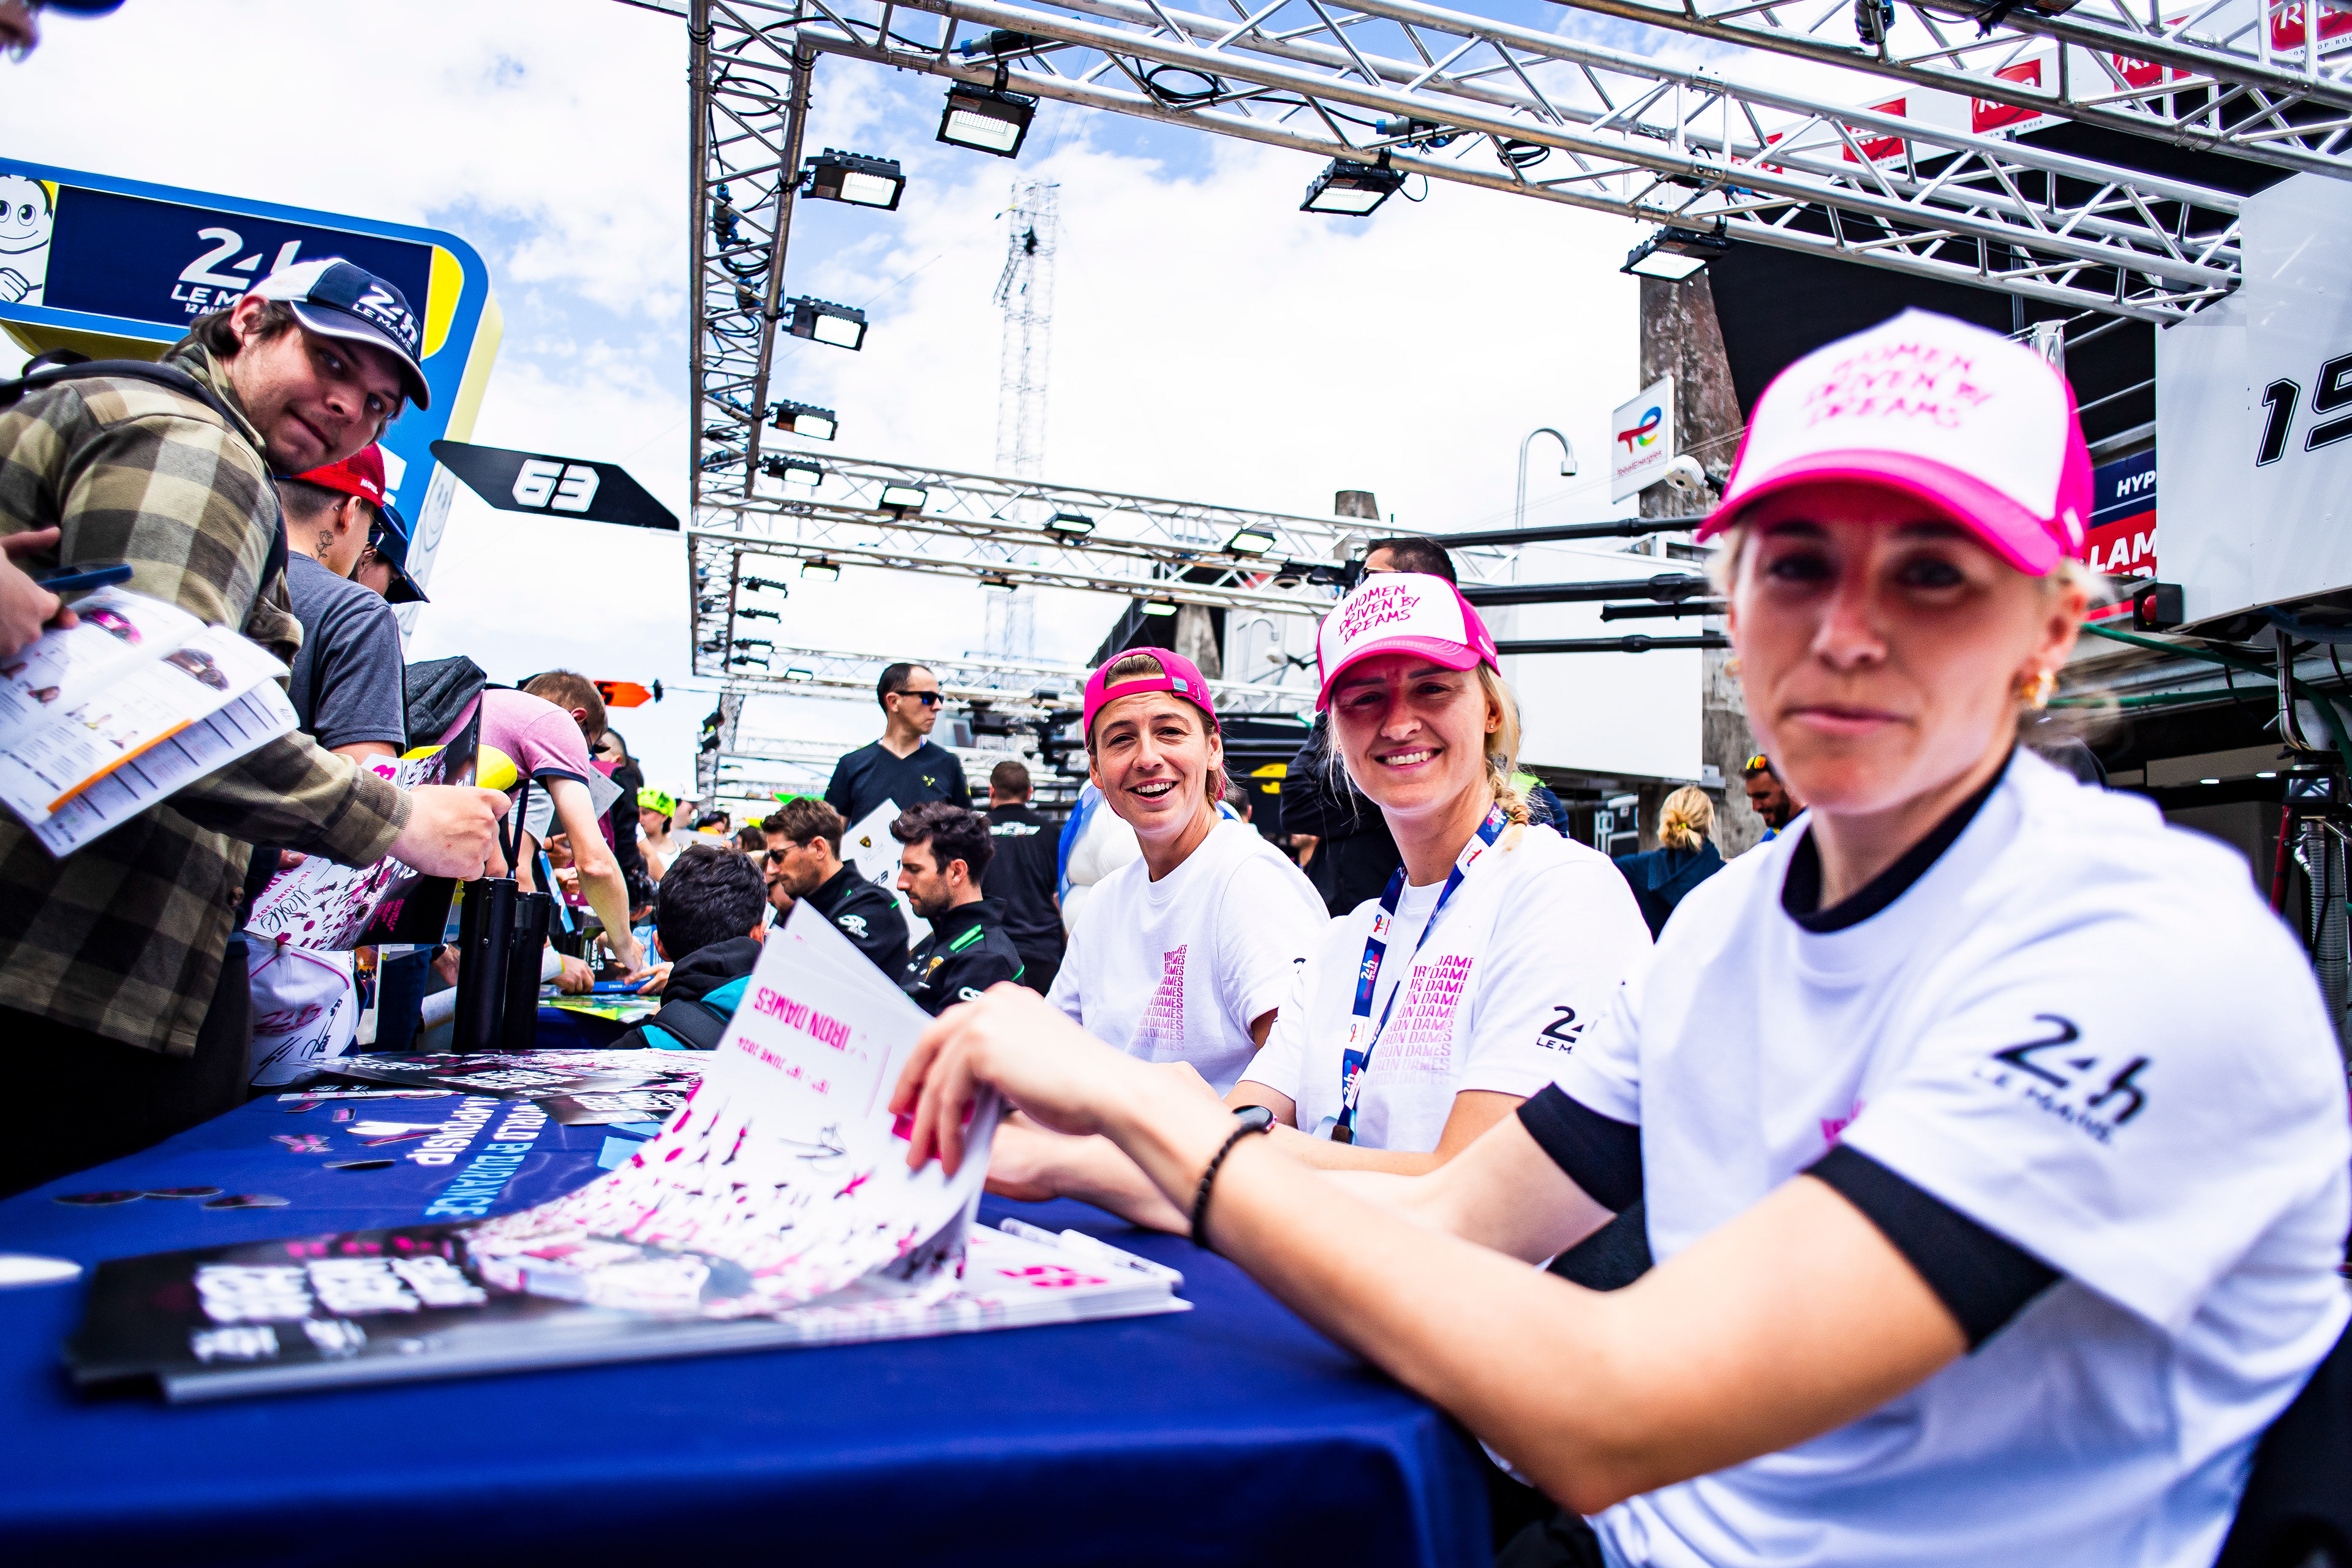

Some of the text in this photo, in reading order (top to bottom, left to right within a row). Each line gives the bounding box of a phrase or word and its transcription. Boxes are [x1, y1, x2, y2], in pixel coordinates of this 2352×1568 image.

[170, 284, 213, 304] LE
[184, 302, 199, 314] 12
[352, 303, 415, 354] LE MANS
[358, 286, 418, 345] 24h
[512, 459, 600, 513] 63
[1345, 585, 1406, 616] WOMEN
[1338, 597, 1420, 636] DRIVEN BY
[1344, 609, 1411, 645] DREAMS
[1360, 960, 1376, 980] 24h
[1152, 1006, 1183, 1019] DAMES
[1153, 997, 1183, 1009] DAMES
[753, 985, 852, 1053] IRON DAMES
[1149, 1028, 1185, 1041] DAMES
[1150, 1017, 1183, 1030] DAMES
[1541, 1006, 1585, 1043] 24
[1405, 1043, 1451, 1057] DAMES
[1536, 1037, 1556, 1049] LE
[1991, 1013, 2152, 1126] 24h
[492, 1104, 549, 1142] WORLD
